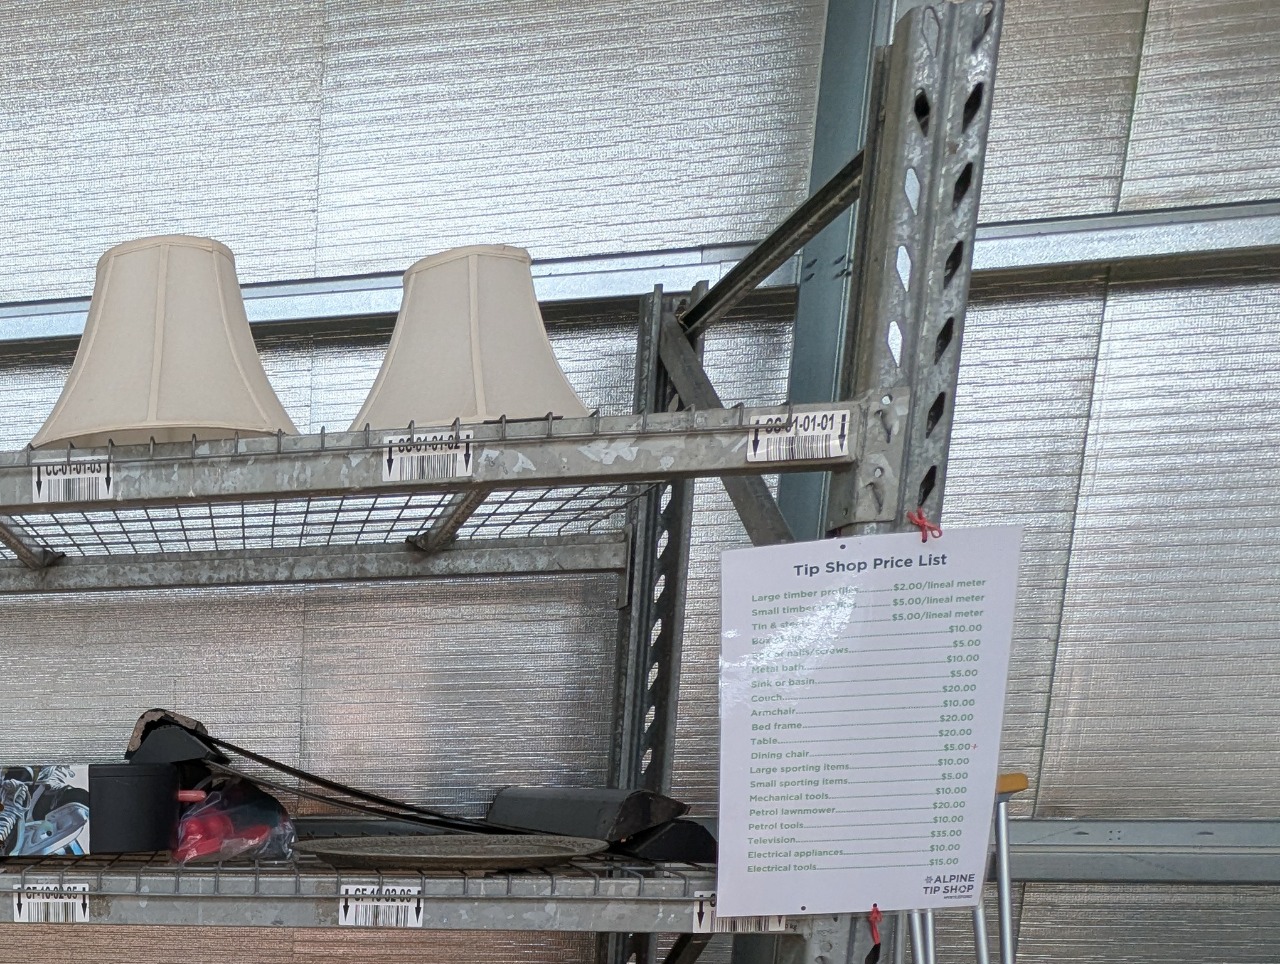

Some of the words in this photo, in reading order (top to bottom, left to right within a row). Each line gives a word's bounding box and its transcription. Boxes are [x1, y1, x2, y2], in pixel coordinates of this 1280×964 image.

[794, 564, 820, 577] Tip
[825, 560, 868, 574] Shop
[873, 557, 914, 570] Price
[919, 554, 948, 566] List
[751, 593, 781, 602] Large
[783, 590, 818, 600] timber
[893, 580, 954, 591] $2.00/lineal
[956, 579, 986, 587] meter
[751, 607, 780, 617] Small
[782, 604, 816, 615] timber
[892, 595, 952, 607] $5.00/lineal
[954, 594, 985, 602] meter
[751, 622, 767, 631] Tin
[770, 621, 777, 629] &
[892, 611, 951, 623] $5.00/lineal
[953, 610, 984, 618] meter
[949, 624, 982, 633] $10.00
[953, 639, 980, 648] $5.00
[751, 665, 780, 674] Metal
[781, 663, 804, 672] bath
[946, 654, 979, 663] $10.00
[751, 679, 772, 688] Sink
[776, 679, 788, 687] or
[790, 677, 815, 686] basin
[950, 669, 978, 678] $5.00
[751, 694, 783, 702] Couch
[942, 684, 977, 693] $20.00
[750, 708, 796, 717] Armchair
[943, 699, 975, 708] $10.00
[751, 722, 771, 731] Bed
[774, 721, 802, 730] frame
[940, 713, 973, 722] $20.00
[750, 737, 778, 746] Table
[938, 728, 972, 737] $20.00
[751, 751, 783, 760] Dining
[786, 750, 809, 759] chair
[750, 765, 778, 775] Large
[780, 764, 821, 774] sporting
[823, 762, 849, 771] items
[937, 757, 969, 766] $10.00
[750, 779, 777, 788] Small
[779, 778, 819, 788] sporting
[822, 776, 848, 785] items
[941, 771, 968, 781] $5.00
[750, 793, 803, 802] Mechanical
[805, 791, 829, 800] tools
[936, 786, 967, 795] $10.00
[749, 807, 778, 816] Petrol
[781, 806, 836, 815] lawnmower
[933, 800, 965, 809] $20.00
[748, 822, 777, 831] Petrol
[780, 821, 804, 829] tools
[933, 815, 963, 824] $10.00
[748, 835, 796, 845] Television
[930, 829, 962, 838] $35.00
[748, 849, 792, 859] Electrical
[795, 848, 843, 858] appliances
[930, 843, 960, 852] $10.00
[747, 864, 791, 873] Electrical
[793, 862, 817, 871] tools
[929, 857, 958, 866] $15.00
[933, 873, 976, 884] ALPINE
[354, 888, 412, 902] CF100206
[922, 885, 941, 895] TIP
[942, 884, 974, 894] SHOP
